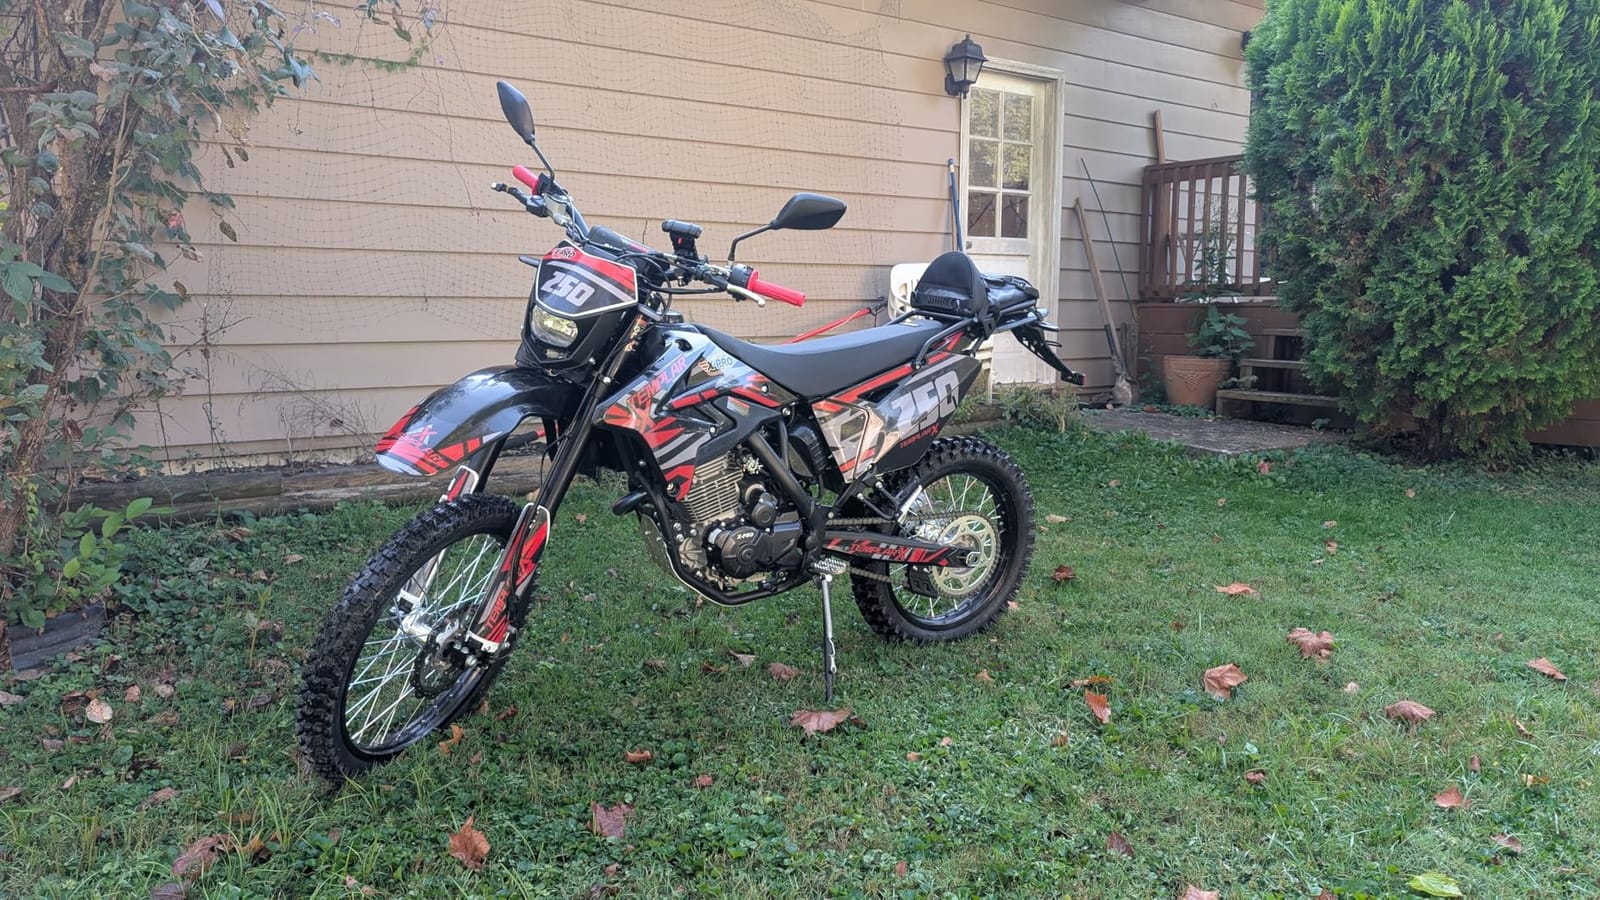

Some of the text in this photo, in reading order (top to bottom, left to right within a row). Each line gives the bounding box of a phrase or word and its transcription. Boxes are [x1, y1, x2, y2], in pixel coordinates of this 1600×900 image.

[540, 271, 595, 307] 250
[628, 354, 686, 407] TEMPLAR
[891, 370, 960, 440] 250
